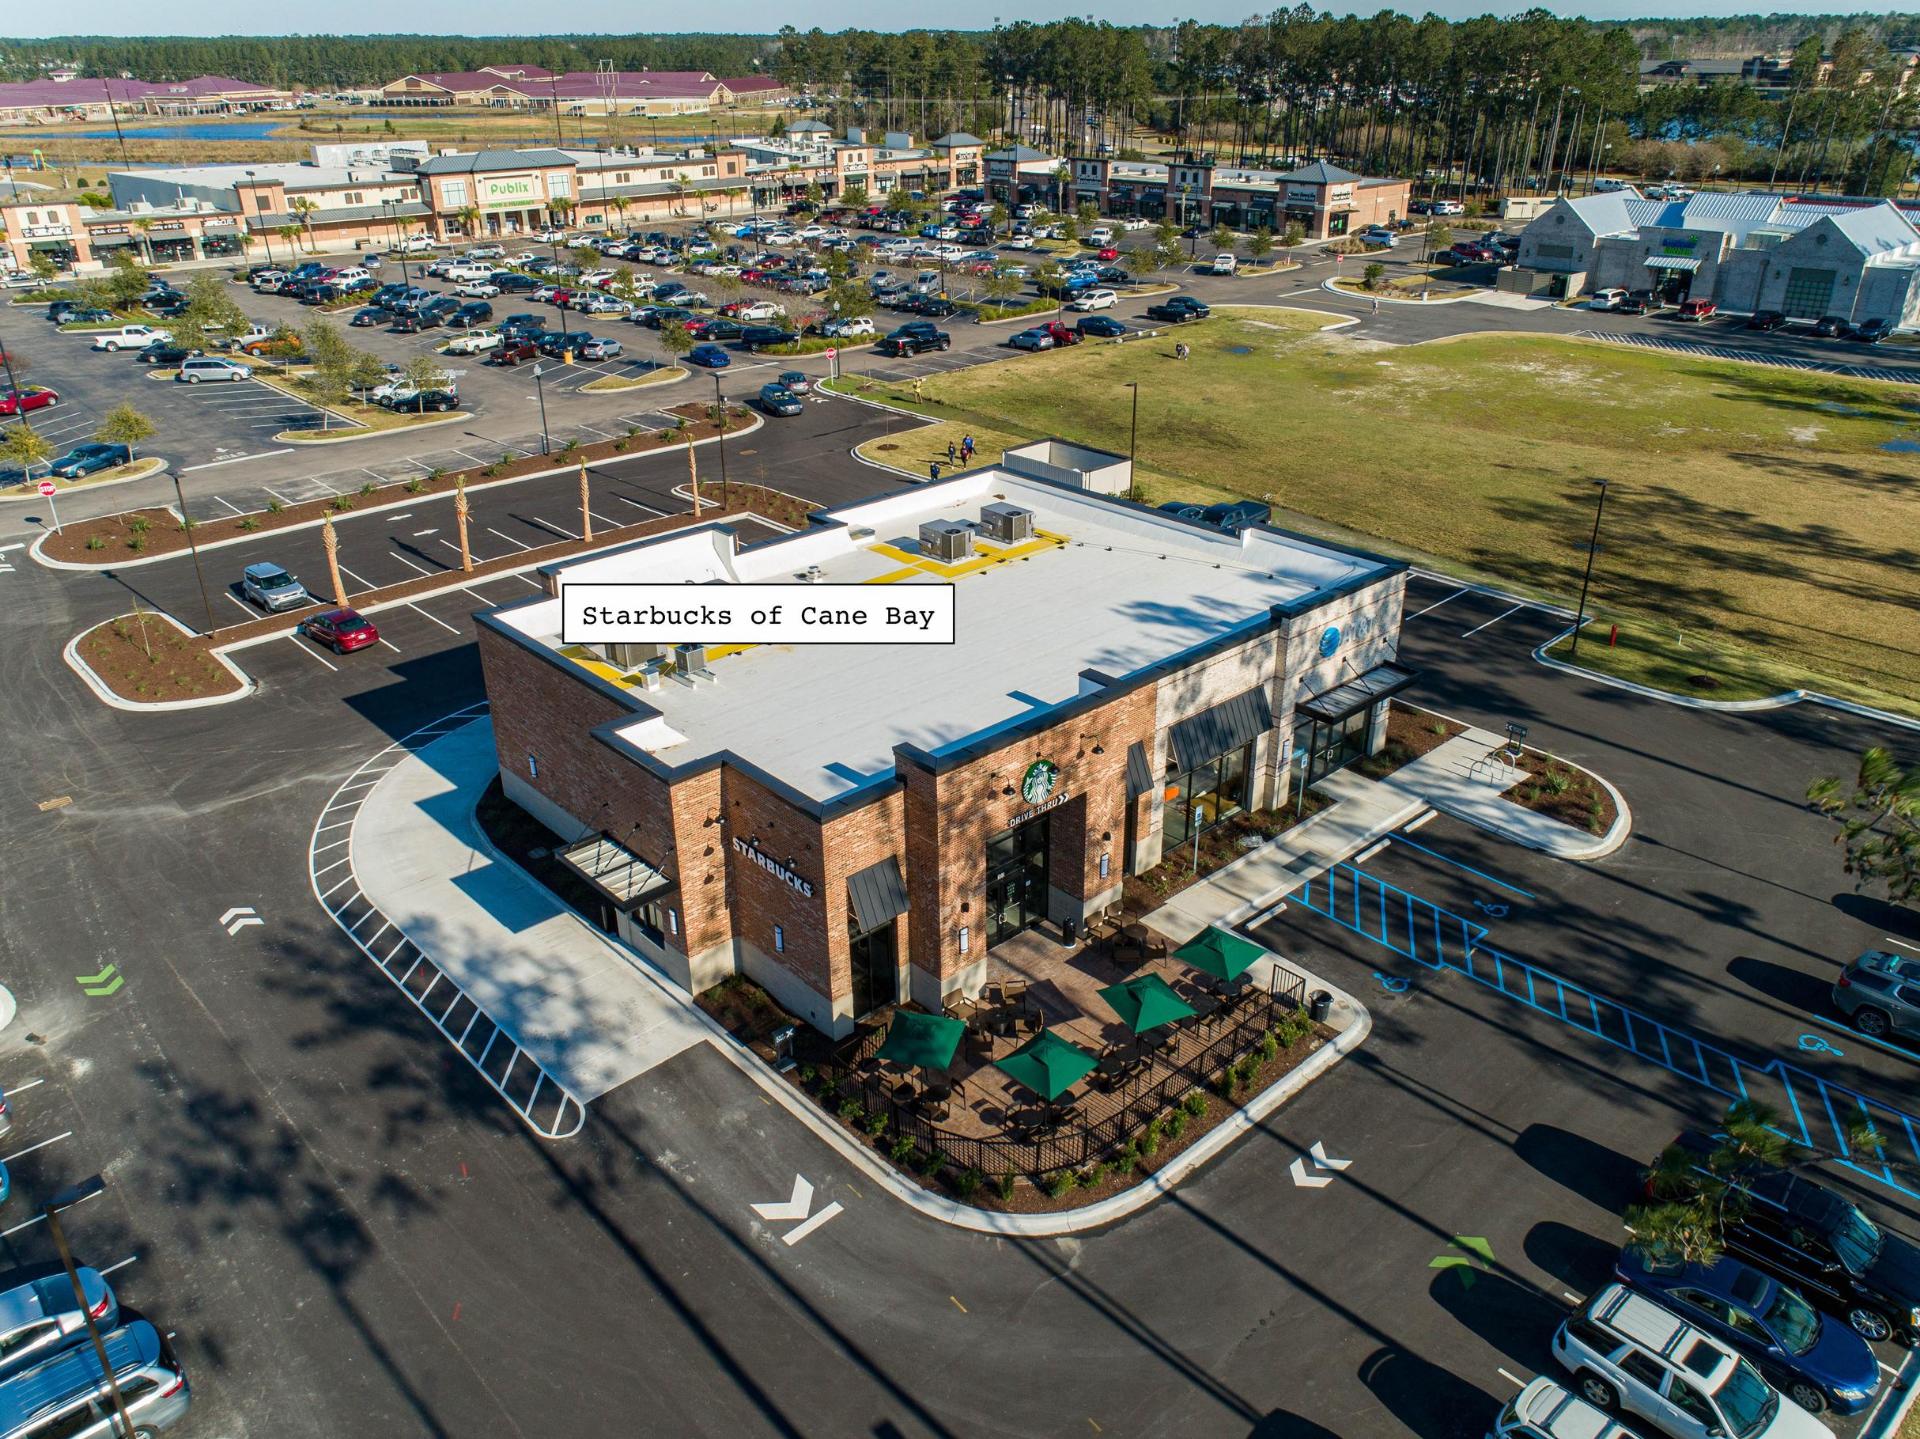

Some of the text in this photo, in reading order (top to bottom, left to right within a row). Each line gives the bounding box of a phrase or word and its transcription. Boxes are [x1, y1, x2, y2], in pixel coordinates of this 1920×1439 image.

[490, 182, 529, 195] Publix
[40, 485, 55, 493] STOP
[1009, 797, 1058, 827] DRIVE THRU
[733, 837, 812, 898] STARBUCKS
